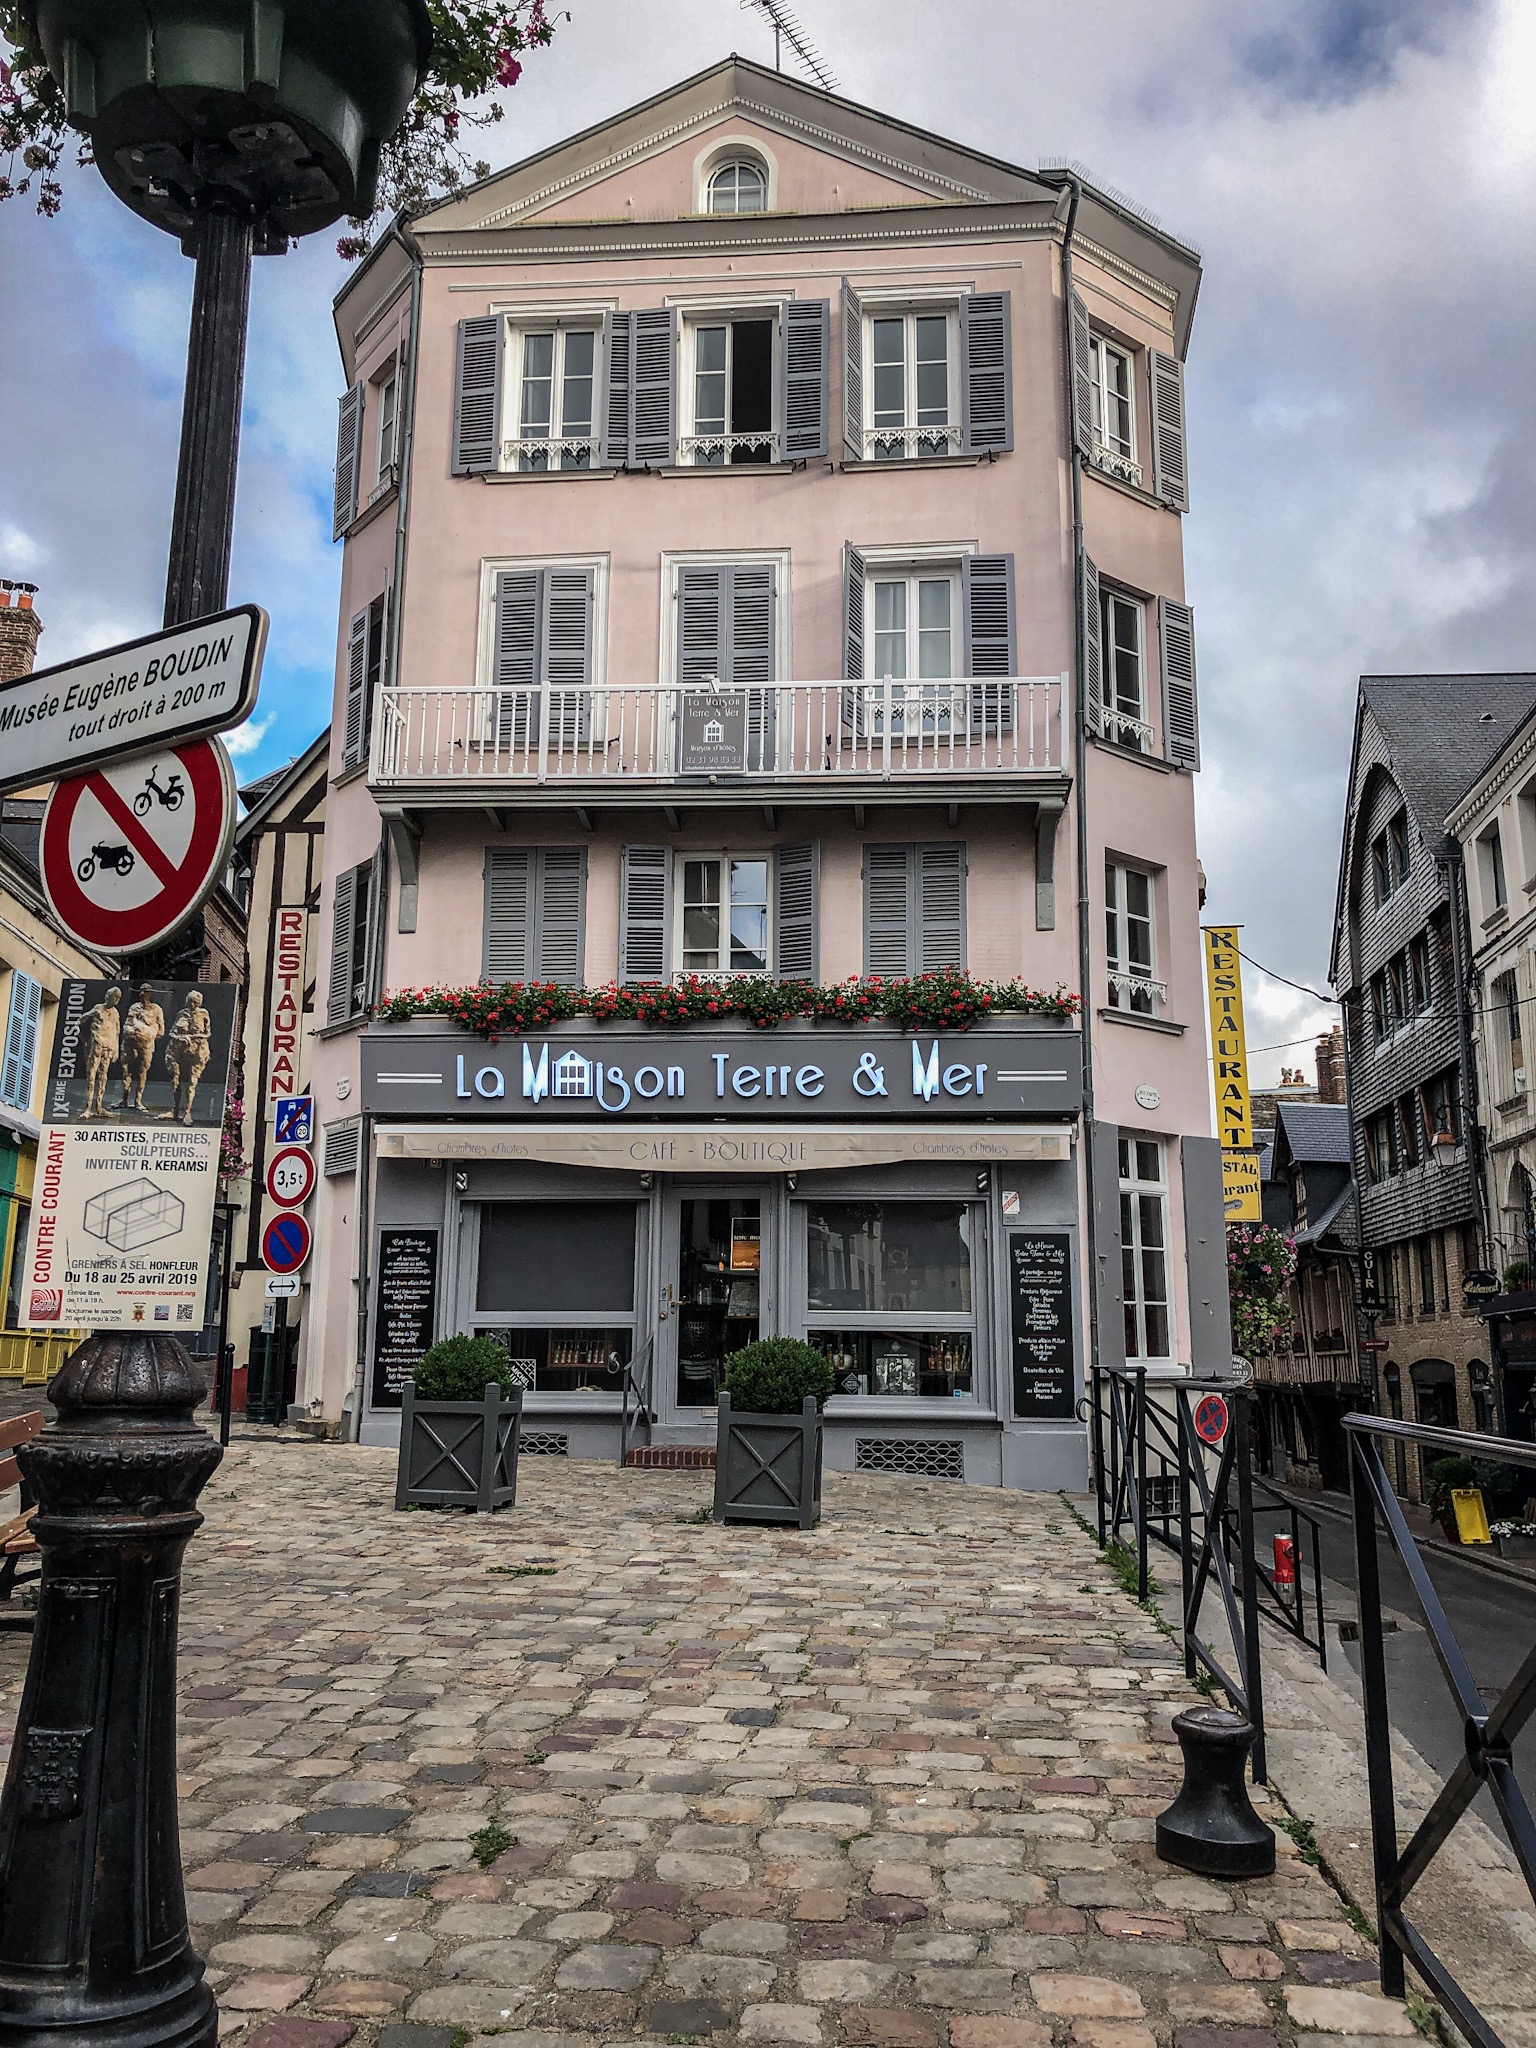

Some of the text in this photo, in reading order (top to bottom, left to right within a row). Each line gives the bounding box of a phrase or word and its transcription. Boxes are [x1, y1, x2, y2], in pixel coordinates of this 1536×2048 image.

[1, 635, 234, 731] Musée Eugène BOUDIN
[69, 681, 225, 742] tout droit à 200 m
[271, 912, 302, 1101] RESTAURAN
[58, 983, 86, 1078] EXPOSITION
[1211, 932, 1246, 1145] RESTAURANT
[457, 1054, 505, 1098] La
[712, 1053, 825, 1098] Terre
[852, 1052, 889, 1098] &
[912, 1040, 988, 1103] Mer
[74, 1131, 211, 1146] 30 ARTISTES, PEINTRES,
[298, 1128, 307, 1136] 20
[437, 1142, 487, 1157] Chambres
[630, 1139, 677, 1160] CAFÉ
[703, 1142, 807, 1165] BOUTIQUE
[913, 1142, 965, 1157] Chambres
[85, 1158, 208, 1172] INVITENT R. KERAMSI
[1223, 1161, 1257, 1175] STAL
[34, 1130, 66, 1283] CONTRE COURANT
[71, 1259, 118, 1270] GRENIERS
[130, 1261, 146, 1270] SEL
[149, 1260, 198, 1271] HONFLEUR
[1363, 1251, 1375, 1289] CUIR
[64, 1271, 197, 1284] Du 18 au 25 avril 2019
[511, 1364, 530, 1386] MICHEL
